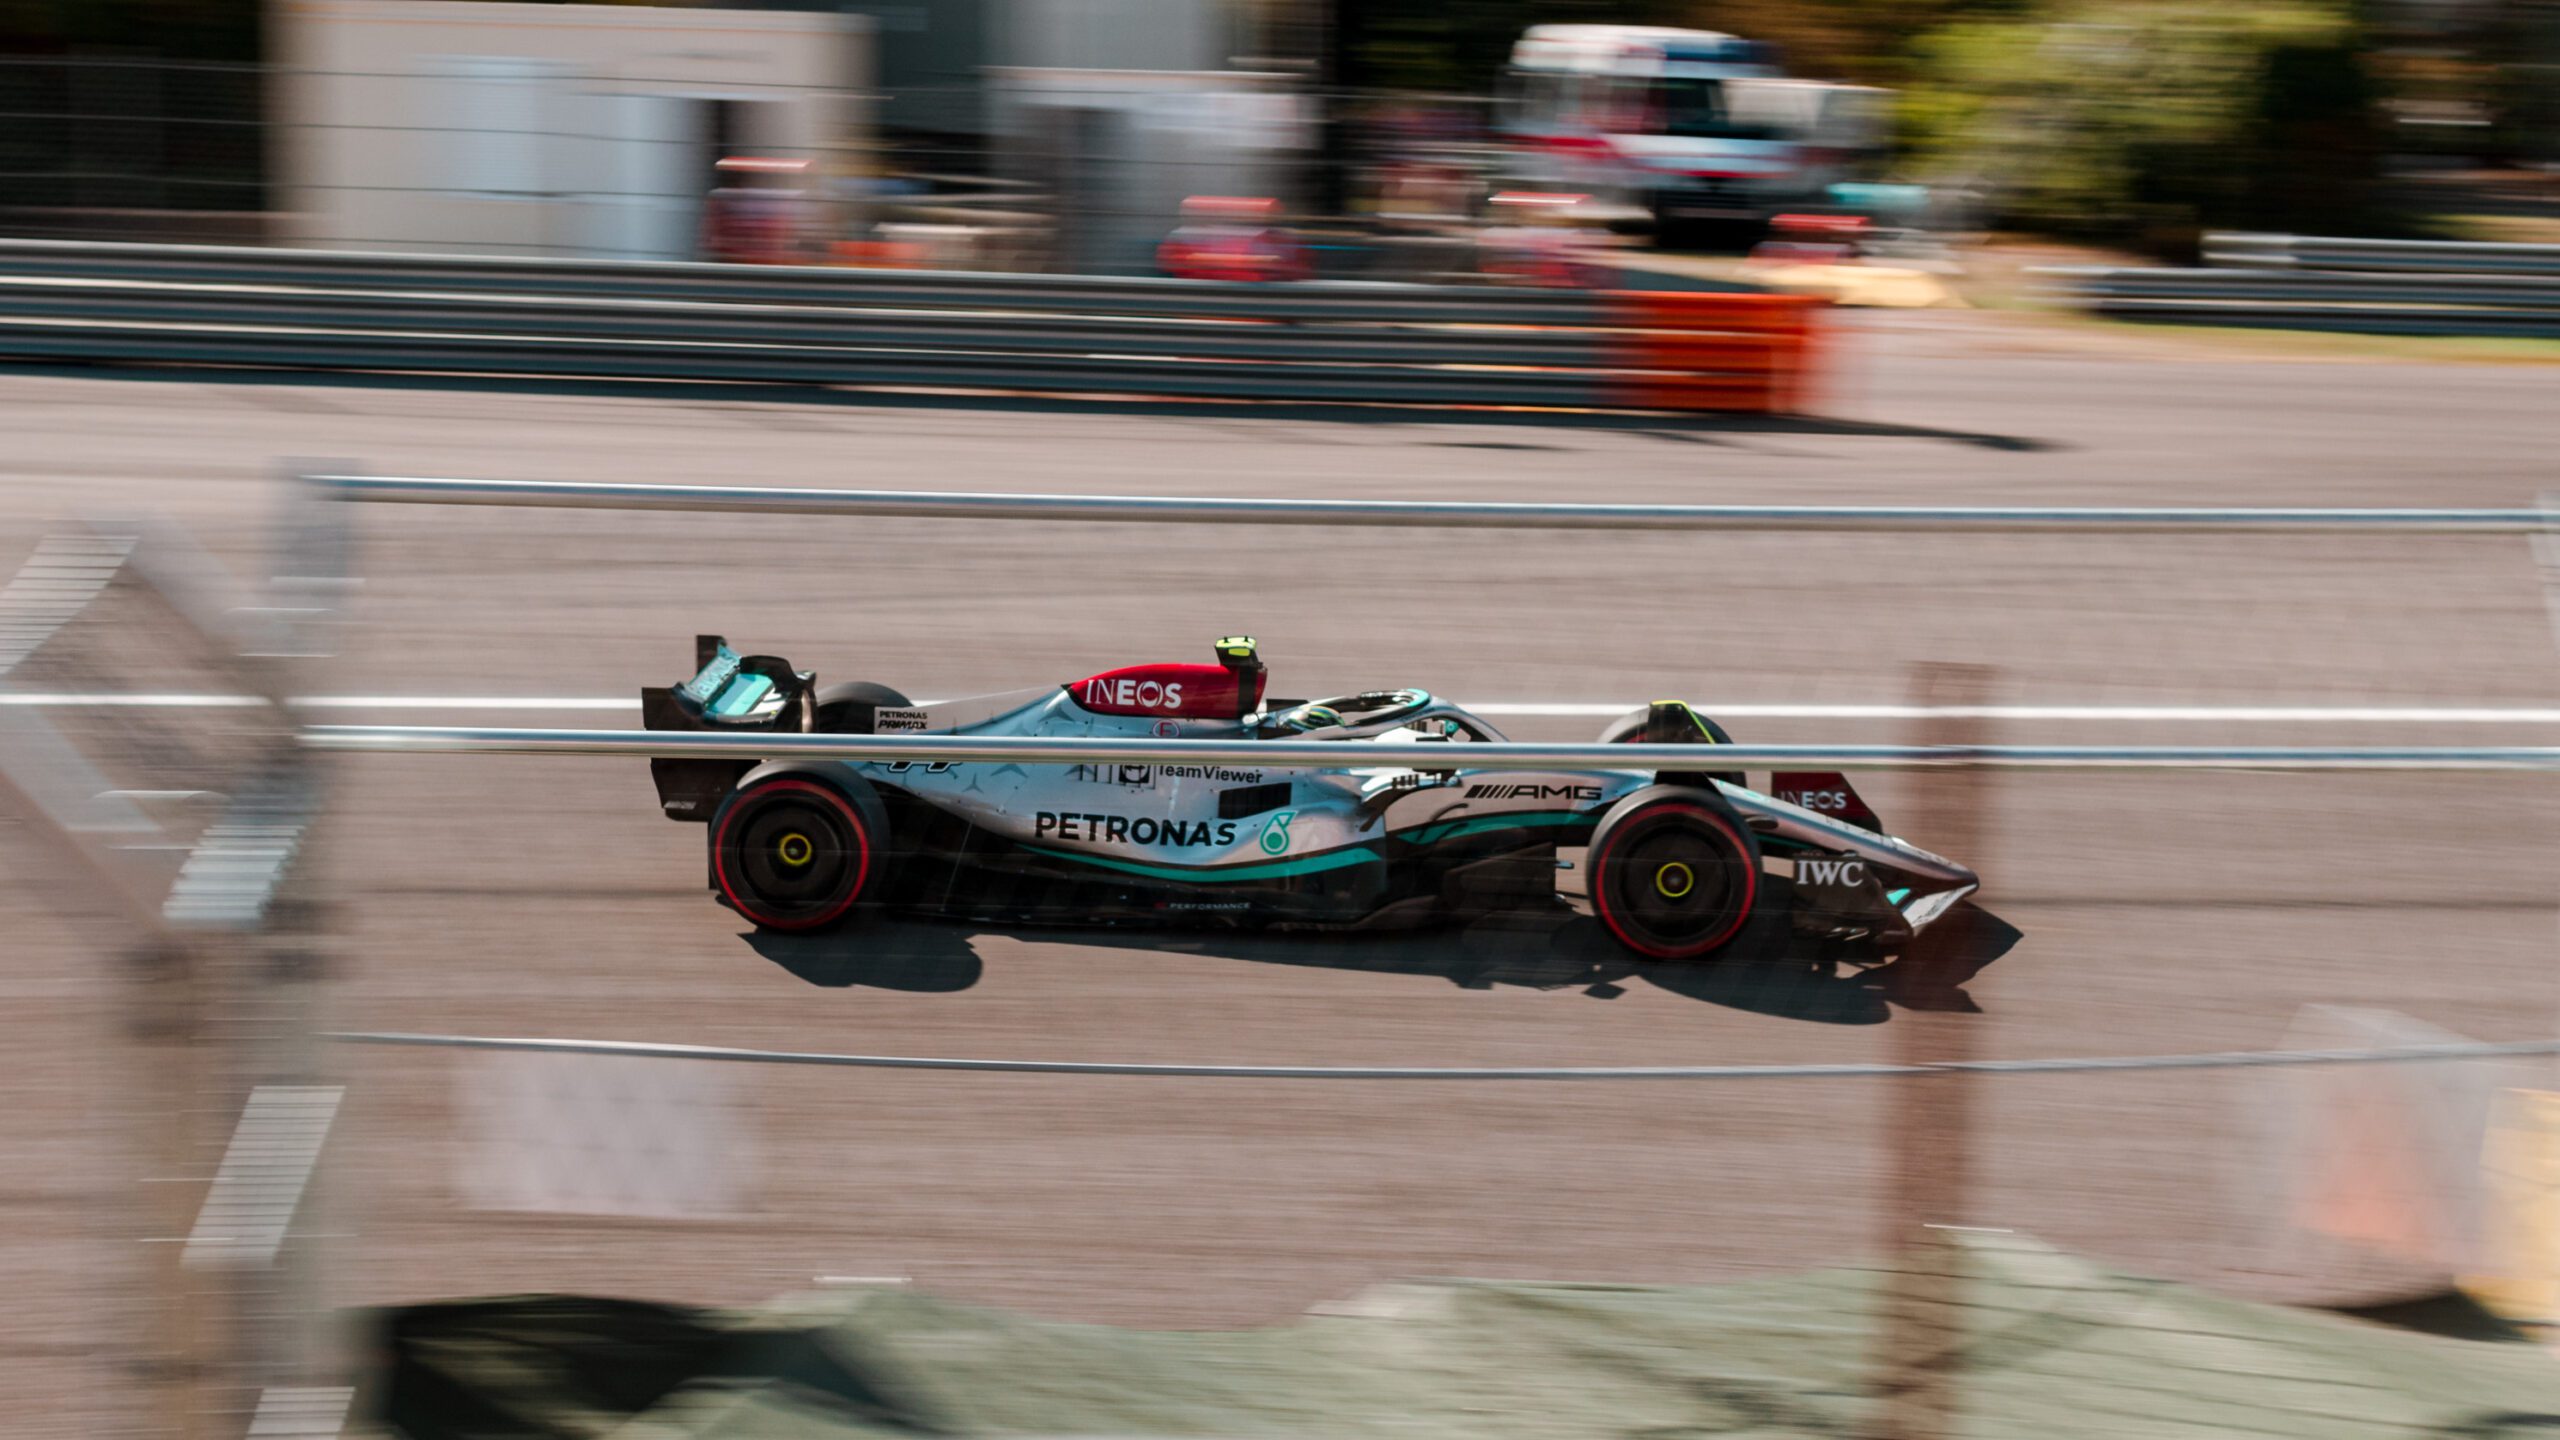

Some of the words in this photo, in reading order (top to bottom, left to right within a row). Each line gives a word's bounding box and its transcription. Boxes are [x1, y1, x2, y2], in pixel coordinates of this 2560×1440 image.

[1084, 679, 1182, 709] INEOS
[879, 710, 928, 720] PETRONAS
[1159, 765, 1264, 784] TeamViewer
[1507, 785, 1603, 800] AMG
[1780, 790, 1847, 810] INEOS
[1034, 811, 1238, 847] PETRONAS
[1796, 860, 1864, 888] IWC
[1169, 902, 1251, 911] PERFORMANCE
